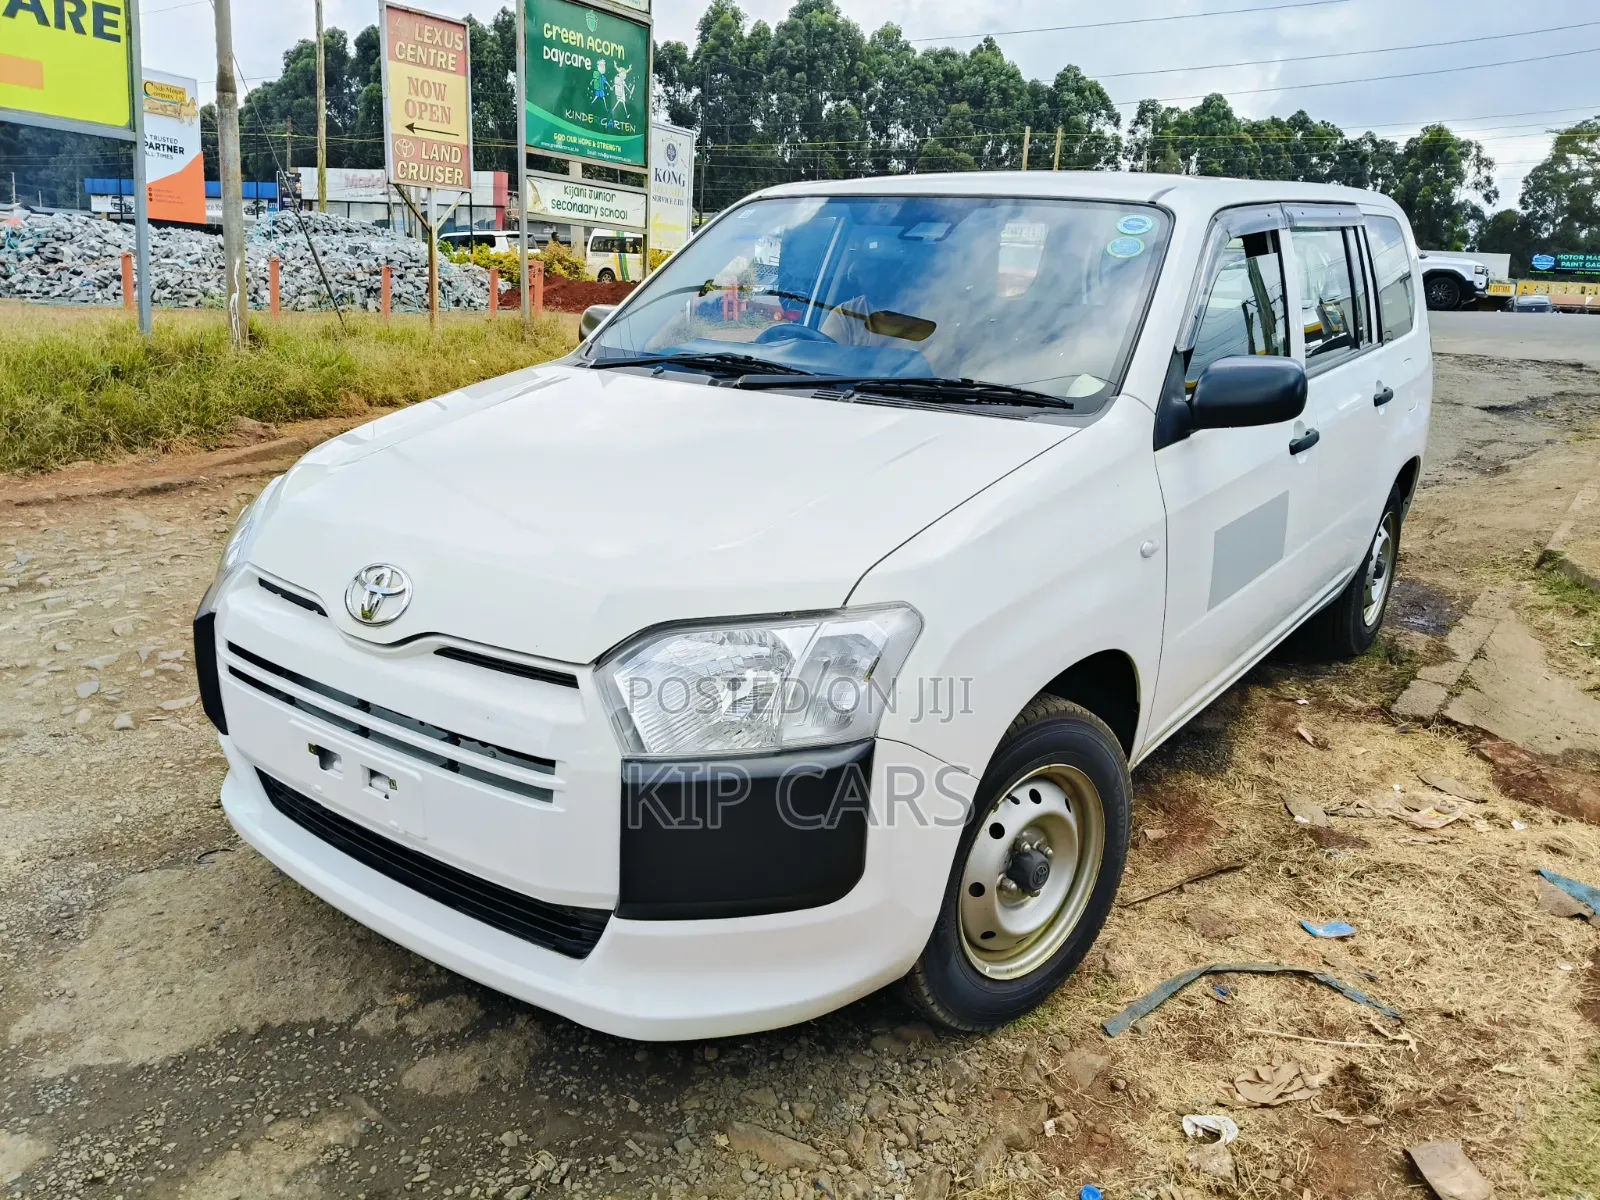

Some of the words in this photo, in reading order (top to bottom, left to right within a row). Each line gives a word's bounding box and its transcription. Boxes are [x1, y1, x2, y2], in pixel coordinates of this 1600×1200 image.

[414, 22, 464, 51] LEXUS
[543, 23, 584, 48] Green
[586, 36, 625, 60] Acorn
[395, 41, 457, 71] CENTRE
[543, 46, 592, 70] Daycare
[407, 76, 447, 102] NOW
[404, 99, 451, 124] OPEN
[600, 118, 636, 134] GARTEN
[145, 141, 185, 155] PARTNER
[150, 134, 178, 144] TRUSTED
[553, 132, 566, 141] GOD
[567, 135, 578, 144] OUR
[578, 137, 592, 146] HOPE
[597, 141, 622, 152] STRENGTH
[157, 152, 173, 160] TIMES
[421, 141, 462, 164] LAND
[397, 160, 464, 186] CRUISER
[654, 167, 686, 188] KONG
[563, 184, 587, 199] Kijani
[588, 189, 616, 203] Junior
[652, 194, 673, 205] SERVICE
[673, 197, 684, 206] LTD
